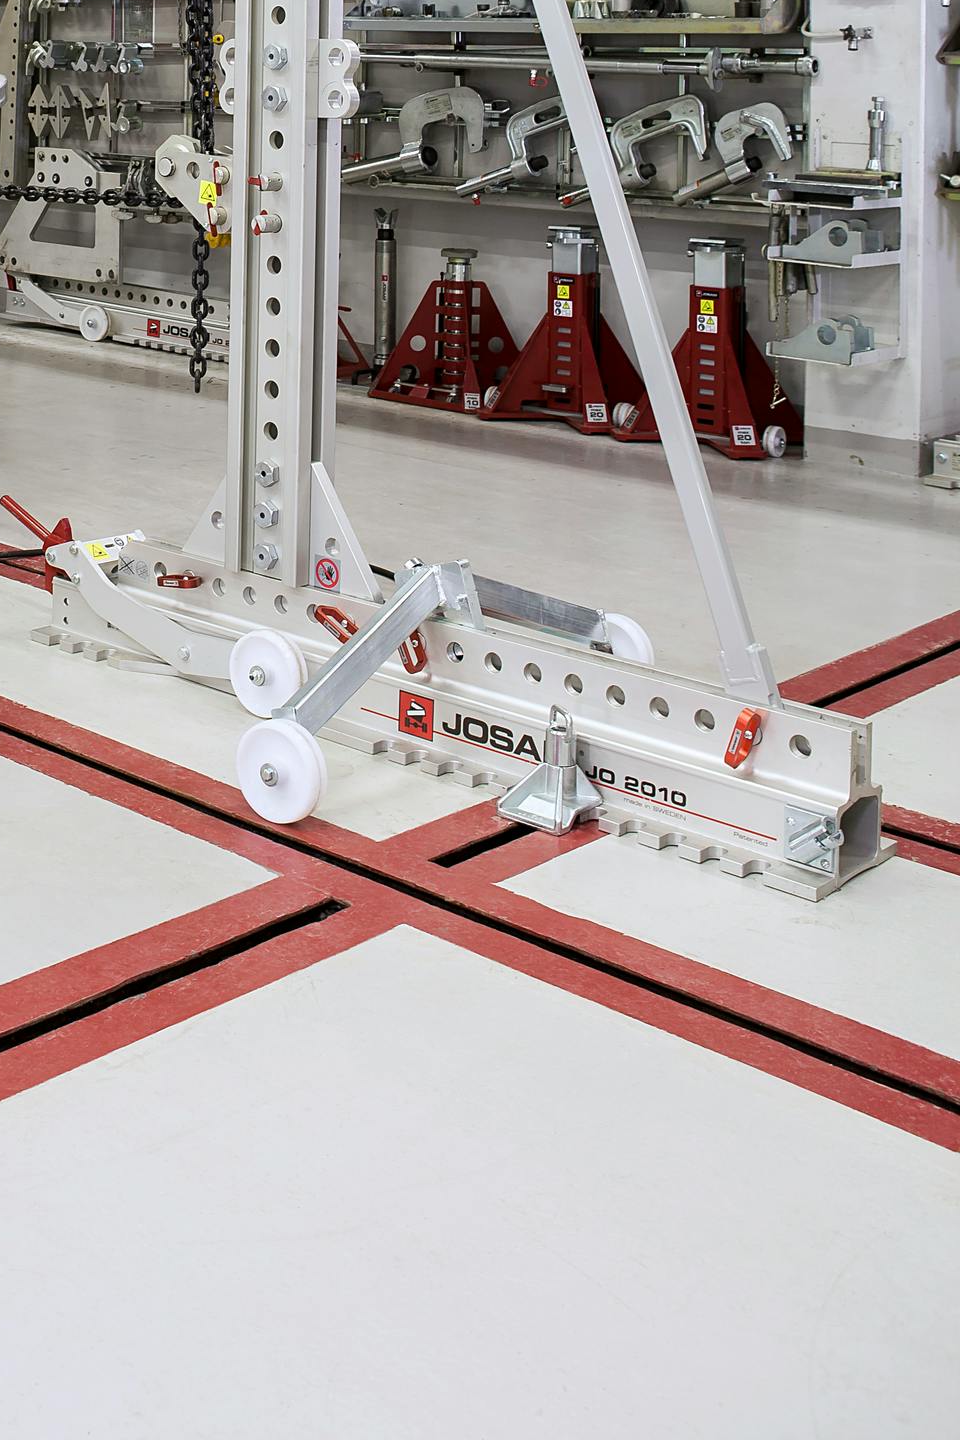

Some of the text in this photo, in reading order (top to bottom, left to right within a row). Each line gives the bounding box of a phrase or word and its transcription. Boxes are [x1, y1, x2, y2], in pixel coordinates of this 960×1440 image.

[442, 713, 545, 763] JOSA
[585, 765, 687, 807] JO 2010
[623, 797, 643, 808] made
[652, 806, 687, 821] SWEDEN
[733, 831, 769, 847] Patented
